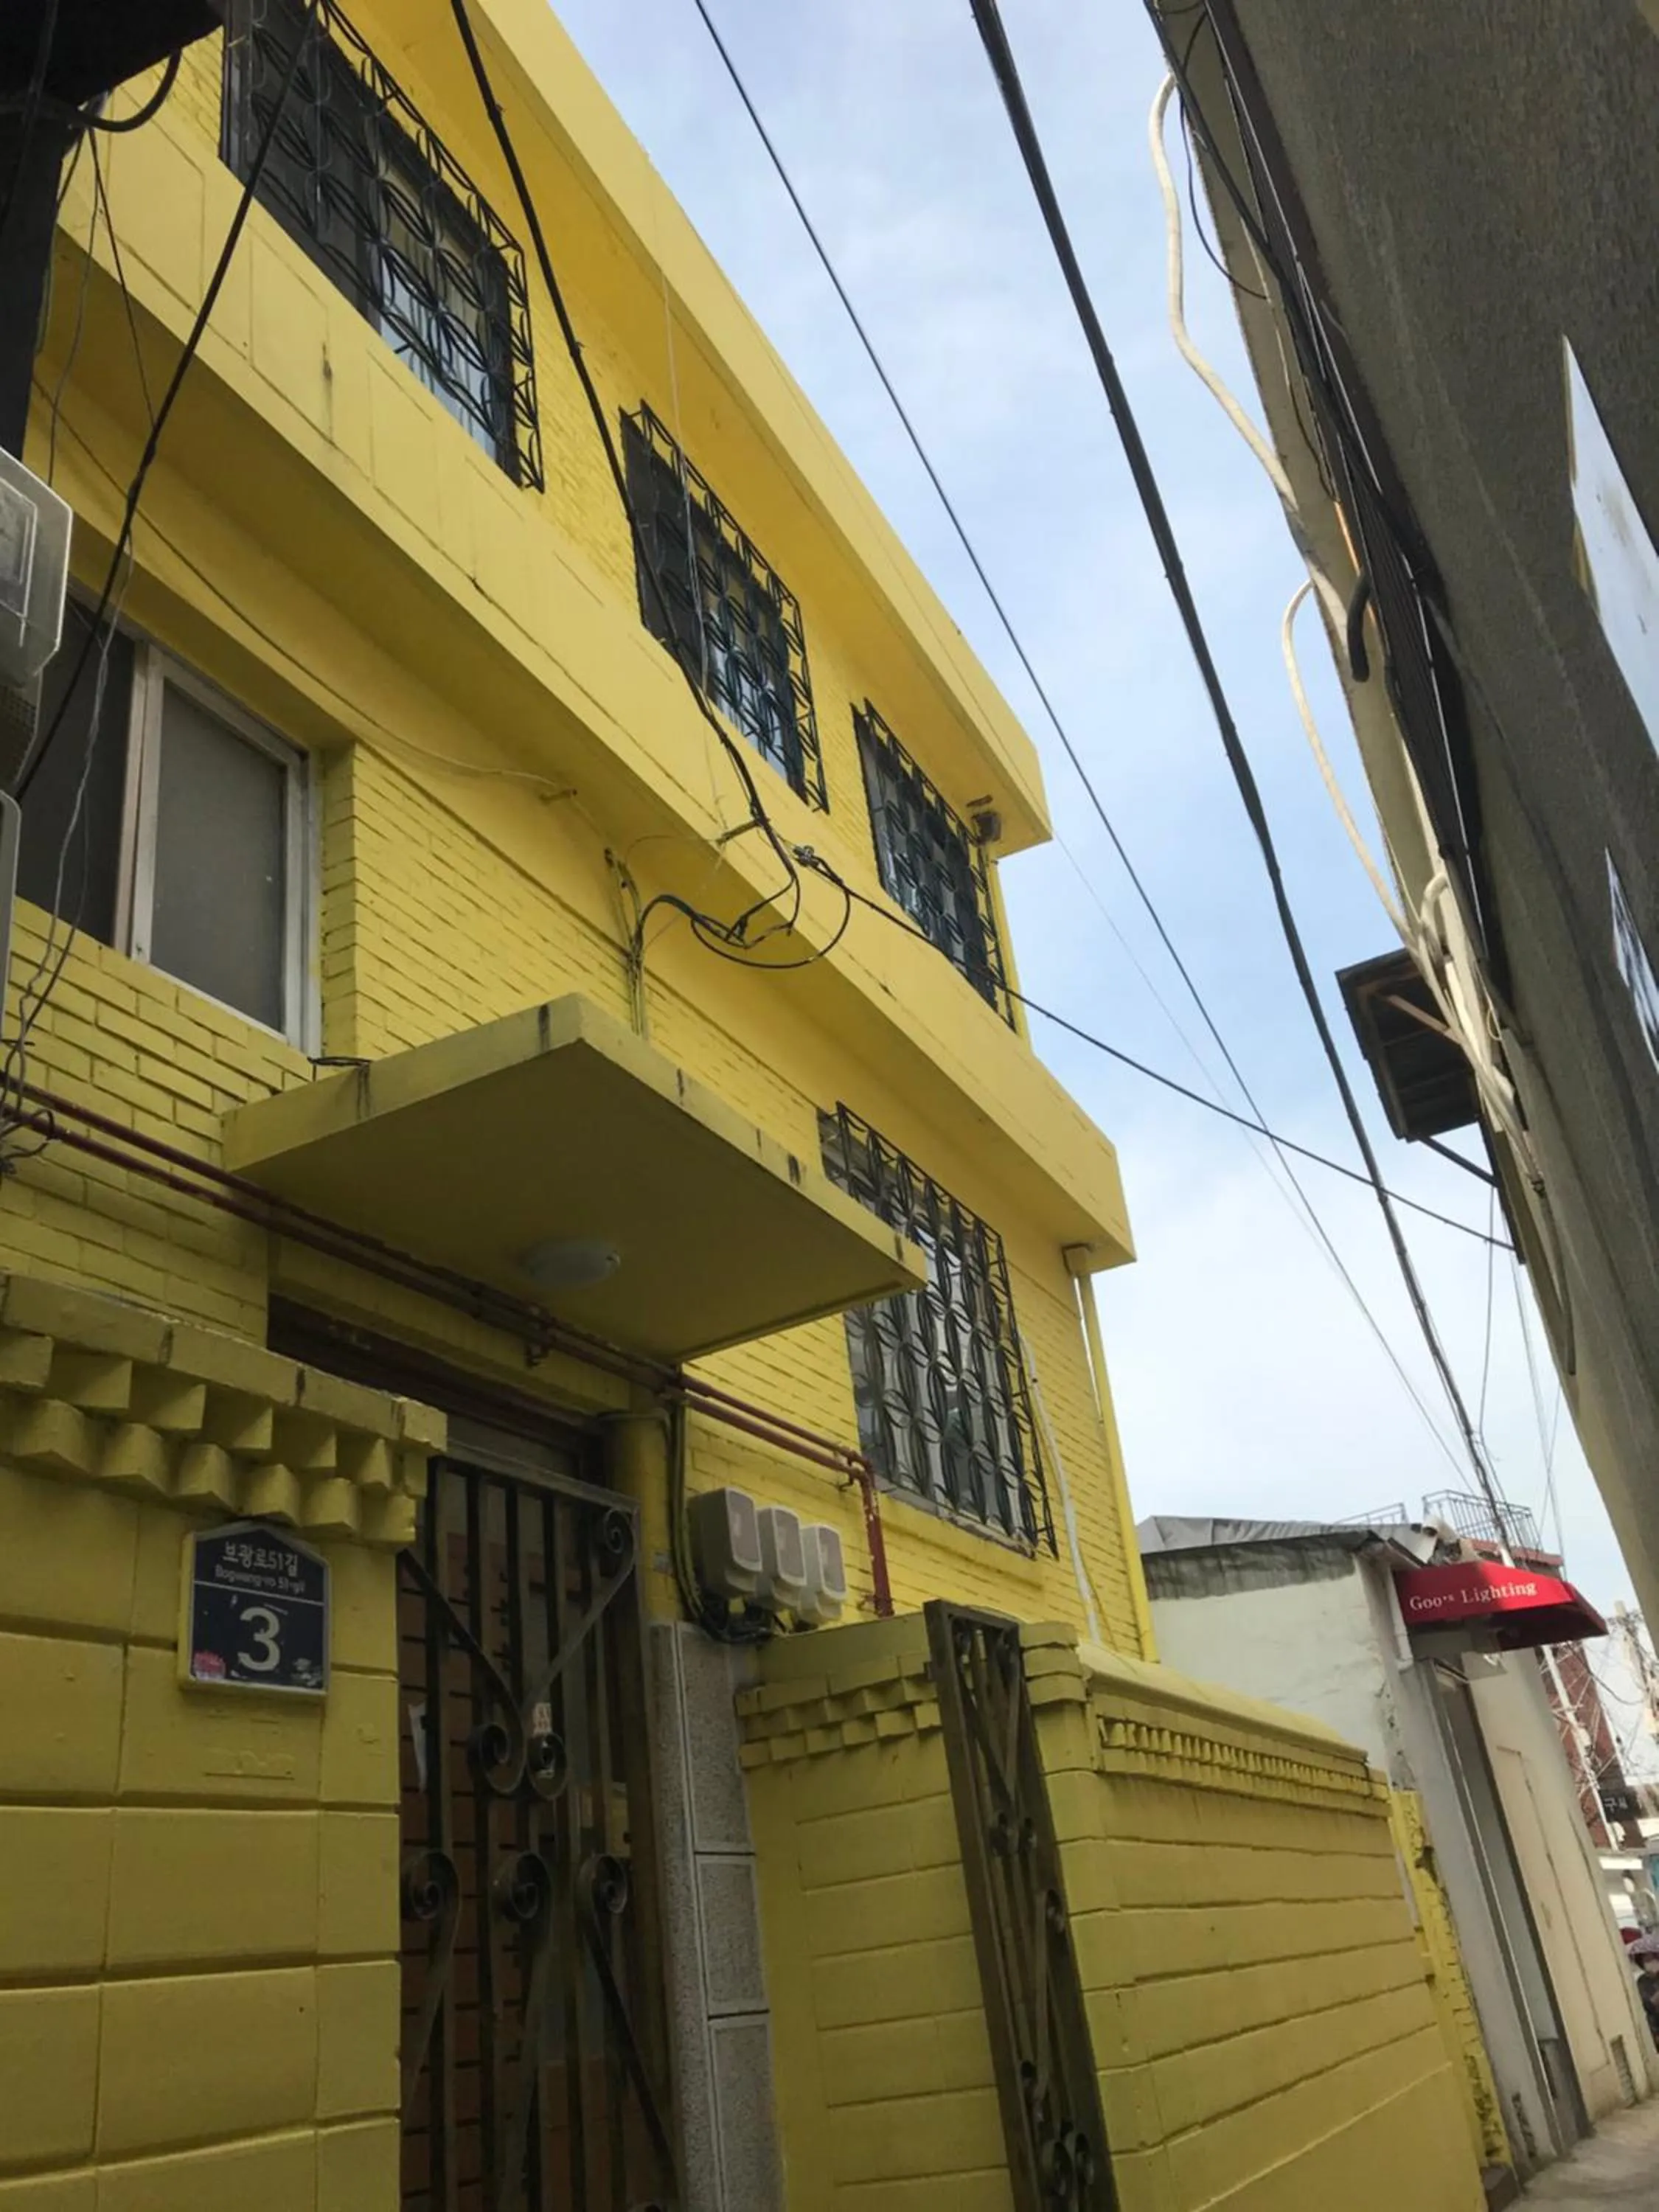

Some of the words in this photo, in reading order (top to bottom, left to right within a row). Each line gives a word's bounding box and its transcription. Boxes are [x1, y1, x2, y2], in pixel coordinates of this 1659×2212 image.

[222, 1541, 298, 1577] 보광로51길
[1461, 1582, 1538, 1604] Lighting
[237, 1606, 282, 1672] 3
